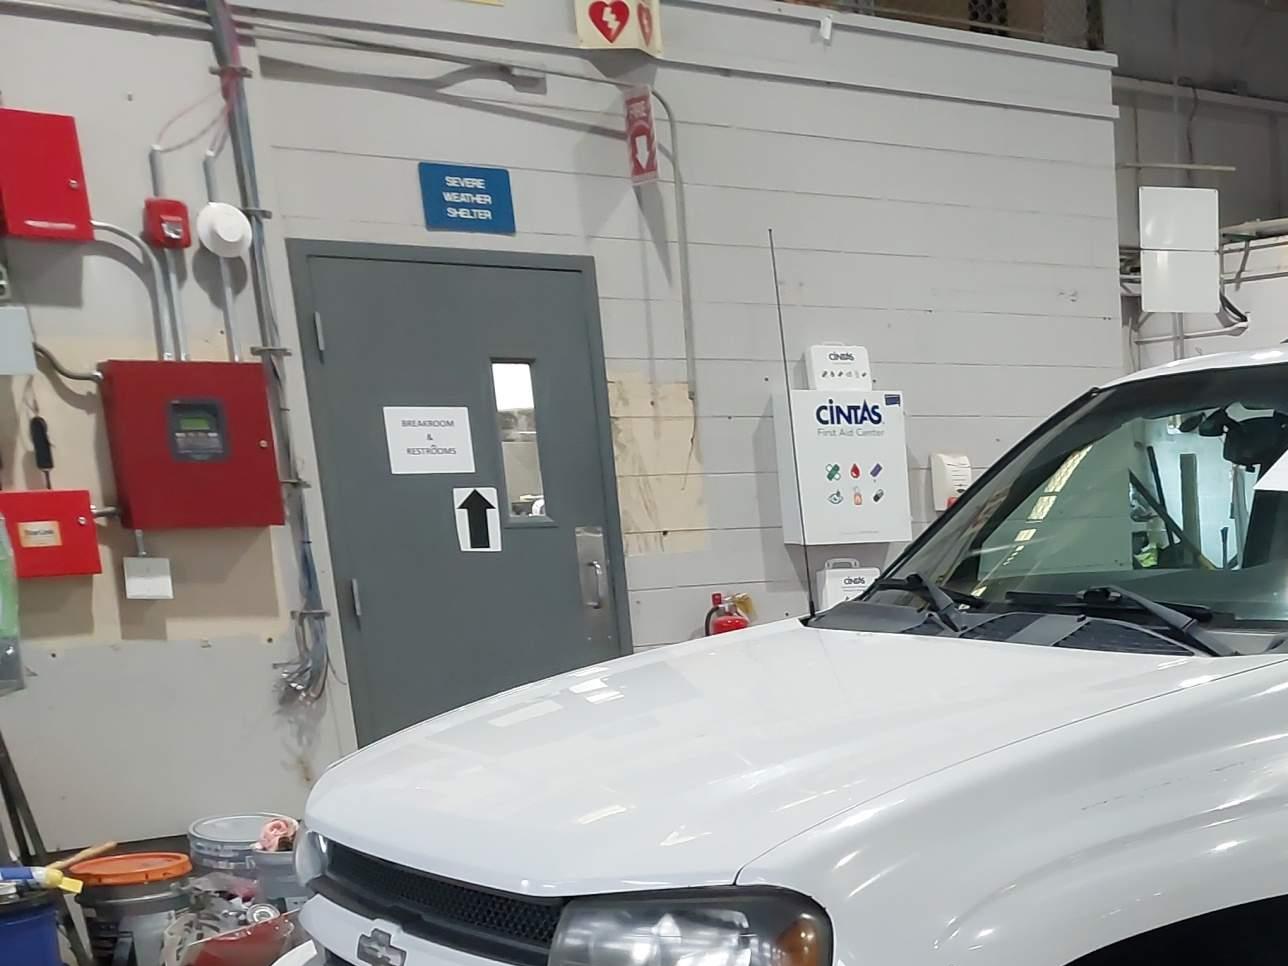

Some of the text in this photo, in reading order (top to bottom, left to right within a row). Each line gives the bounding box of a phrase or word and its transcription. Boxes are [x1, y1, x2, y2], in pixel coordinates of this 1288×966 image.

[444, 175, 486, 190] SEVERE
[442, 191, 493, 205] WEATHER
[446, 207, 493, 221] SHELTER
[401, 419, 455, 428] BREAKROOM
[406, 447, 457, 456] RESTROOMS
